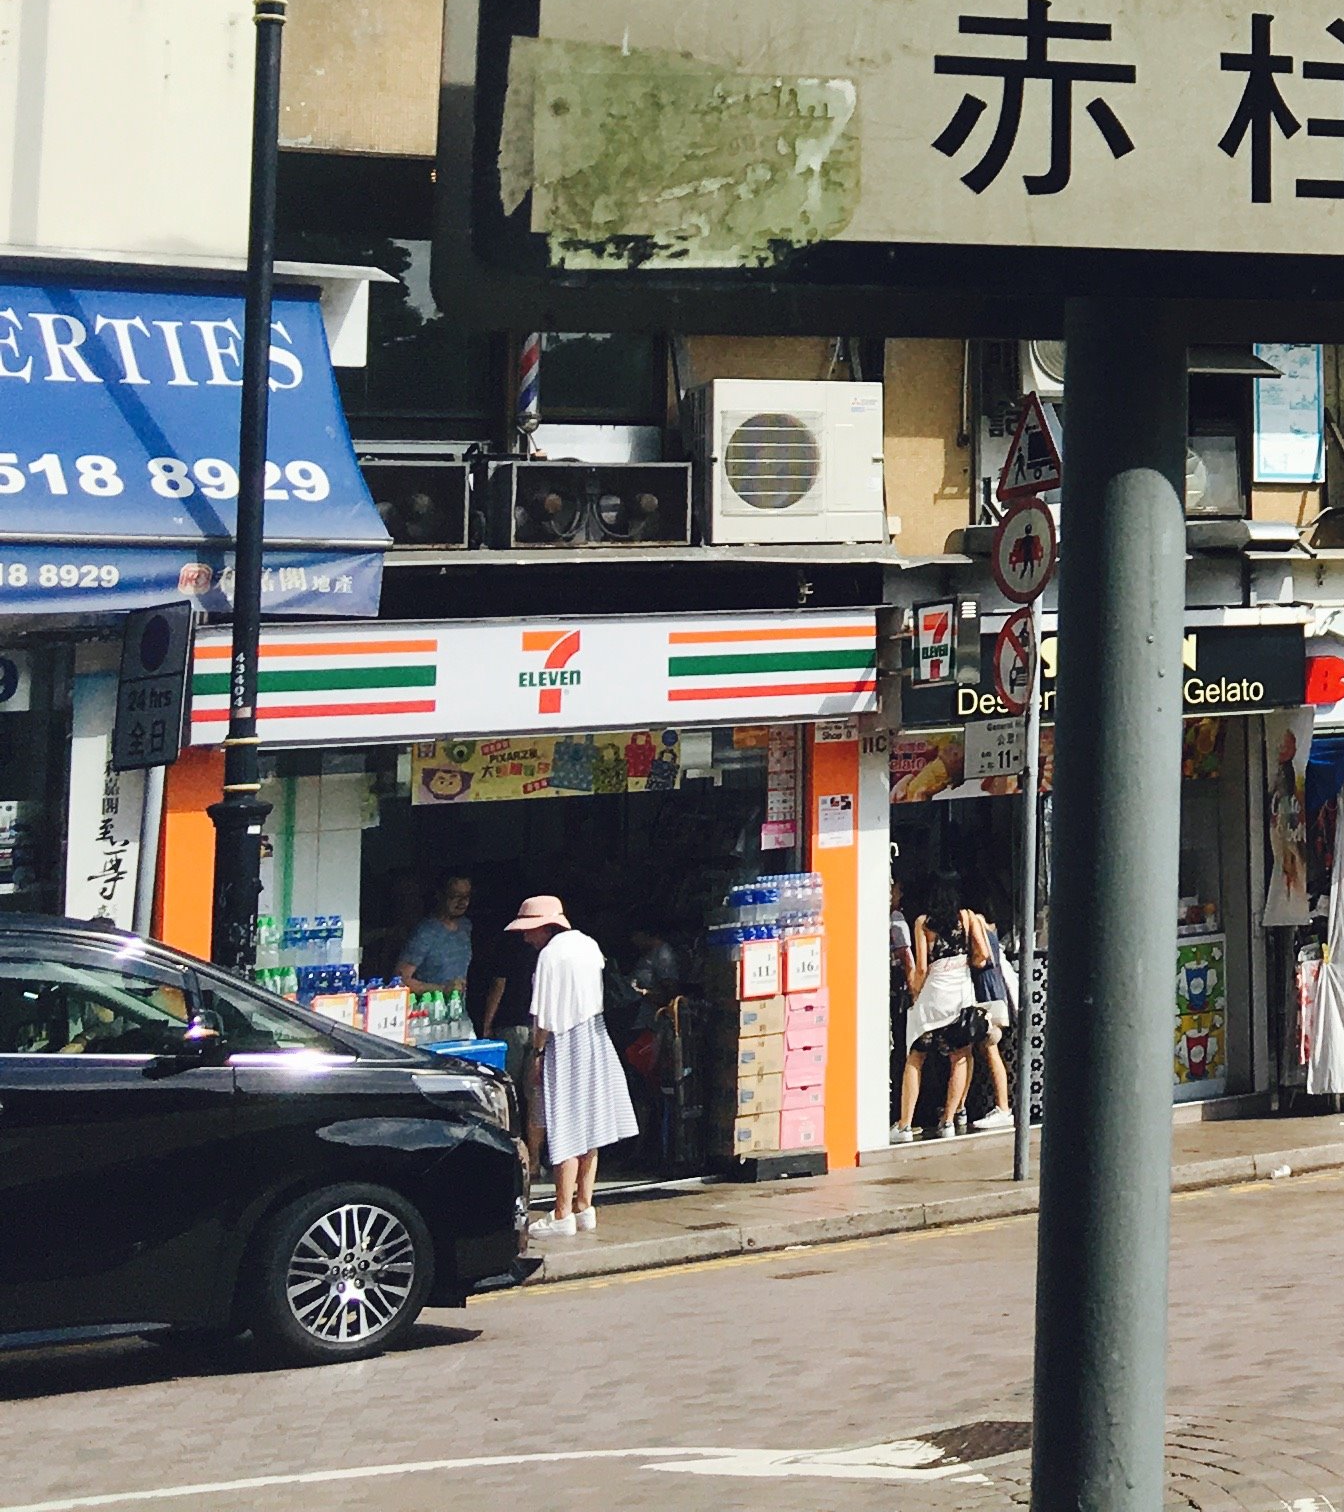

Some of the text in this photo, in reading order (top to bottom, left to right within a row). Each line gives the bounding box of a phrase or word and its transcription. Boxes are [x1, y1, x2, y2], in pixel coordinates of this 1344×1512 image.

[147, 457, 331, 502] 8929
[39, 564, 120, 588] 8929
[1183, 676, 1264, 705] Gelato
